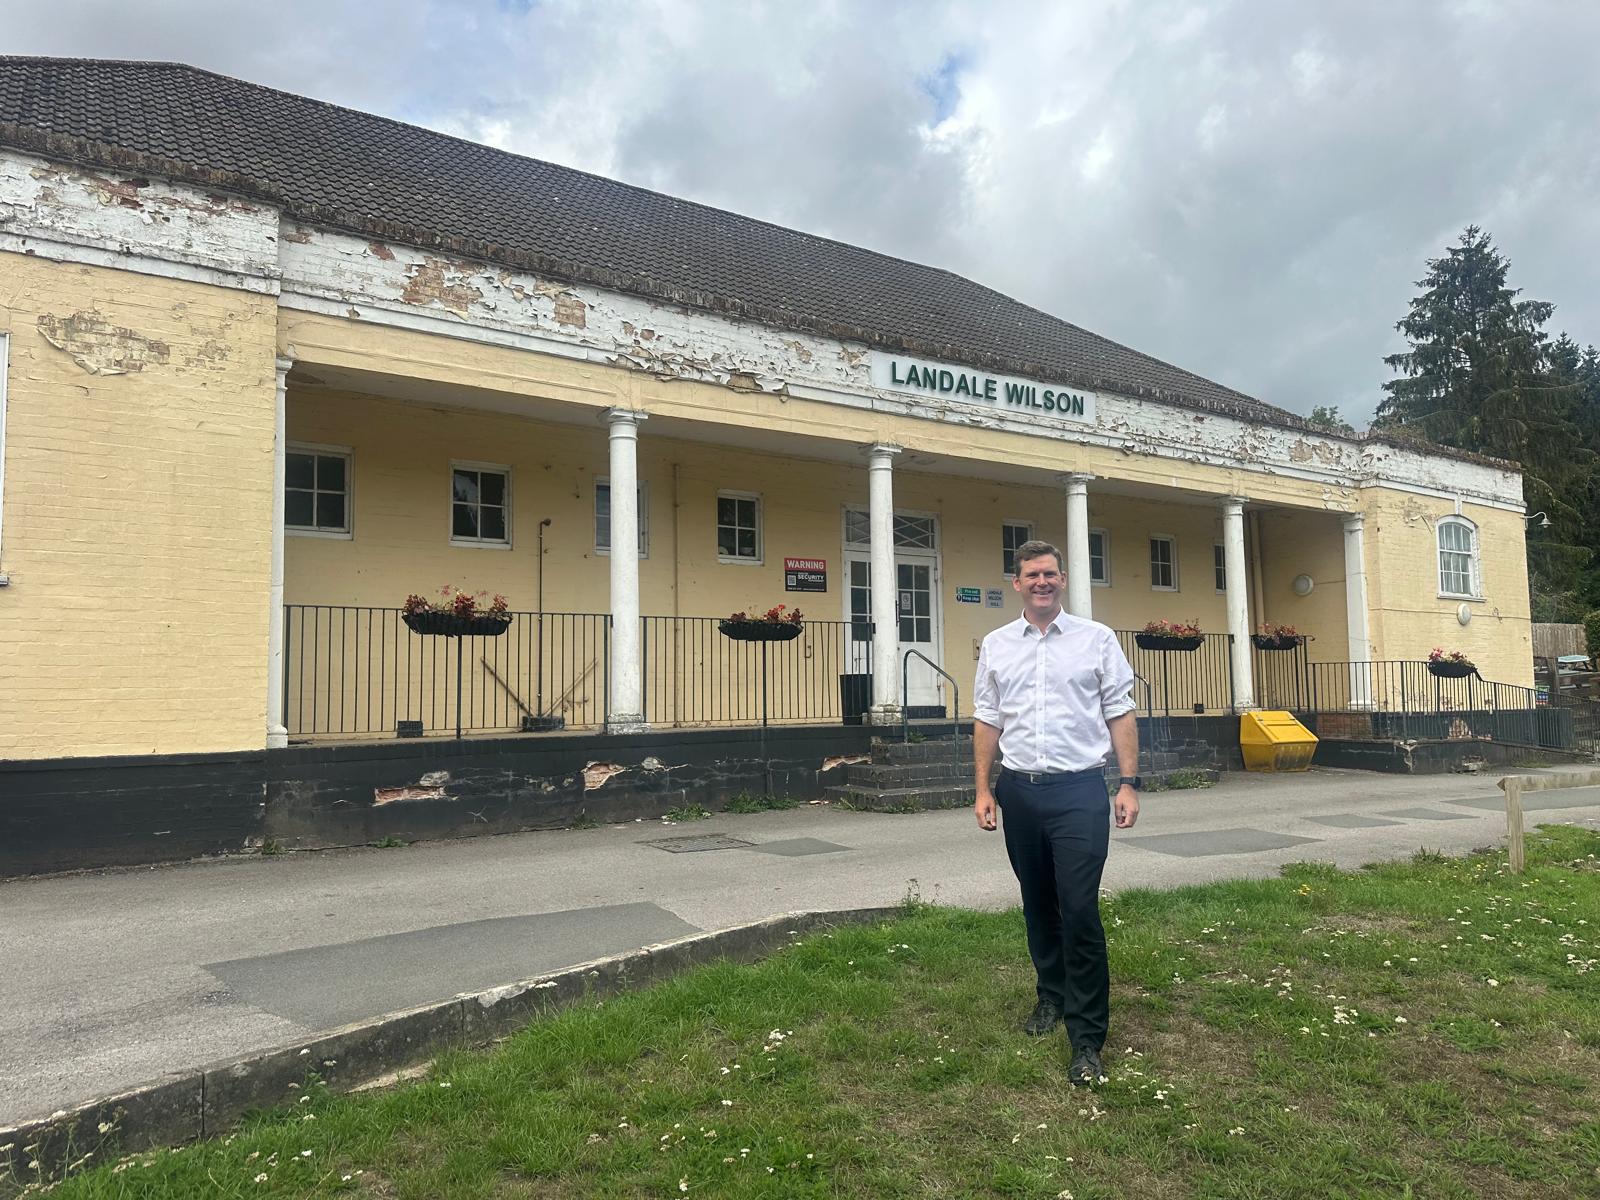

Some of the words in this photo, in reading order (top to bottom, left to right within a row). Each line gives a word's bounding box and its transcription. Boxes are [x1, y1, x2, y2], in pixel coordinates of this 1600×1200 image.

[891, 361, 997, 400] LANDALE
[1005, 382, 1084, 416] WILSON
[786, 559, 824, 570] WARNING
